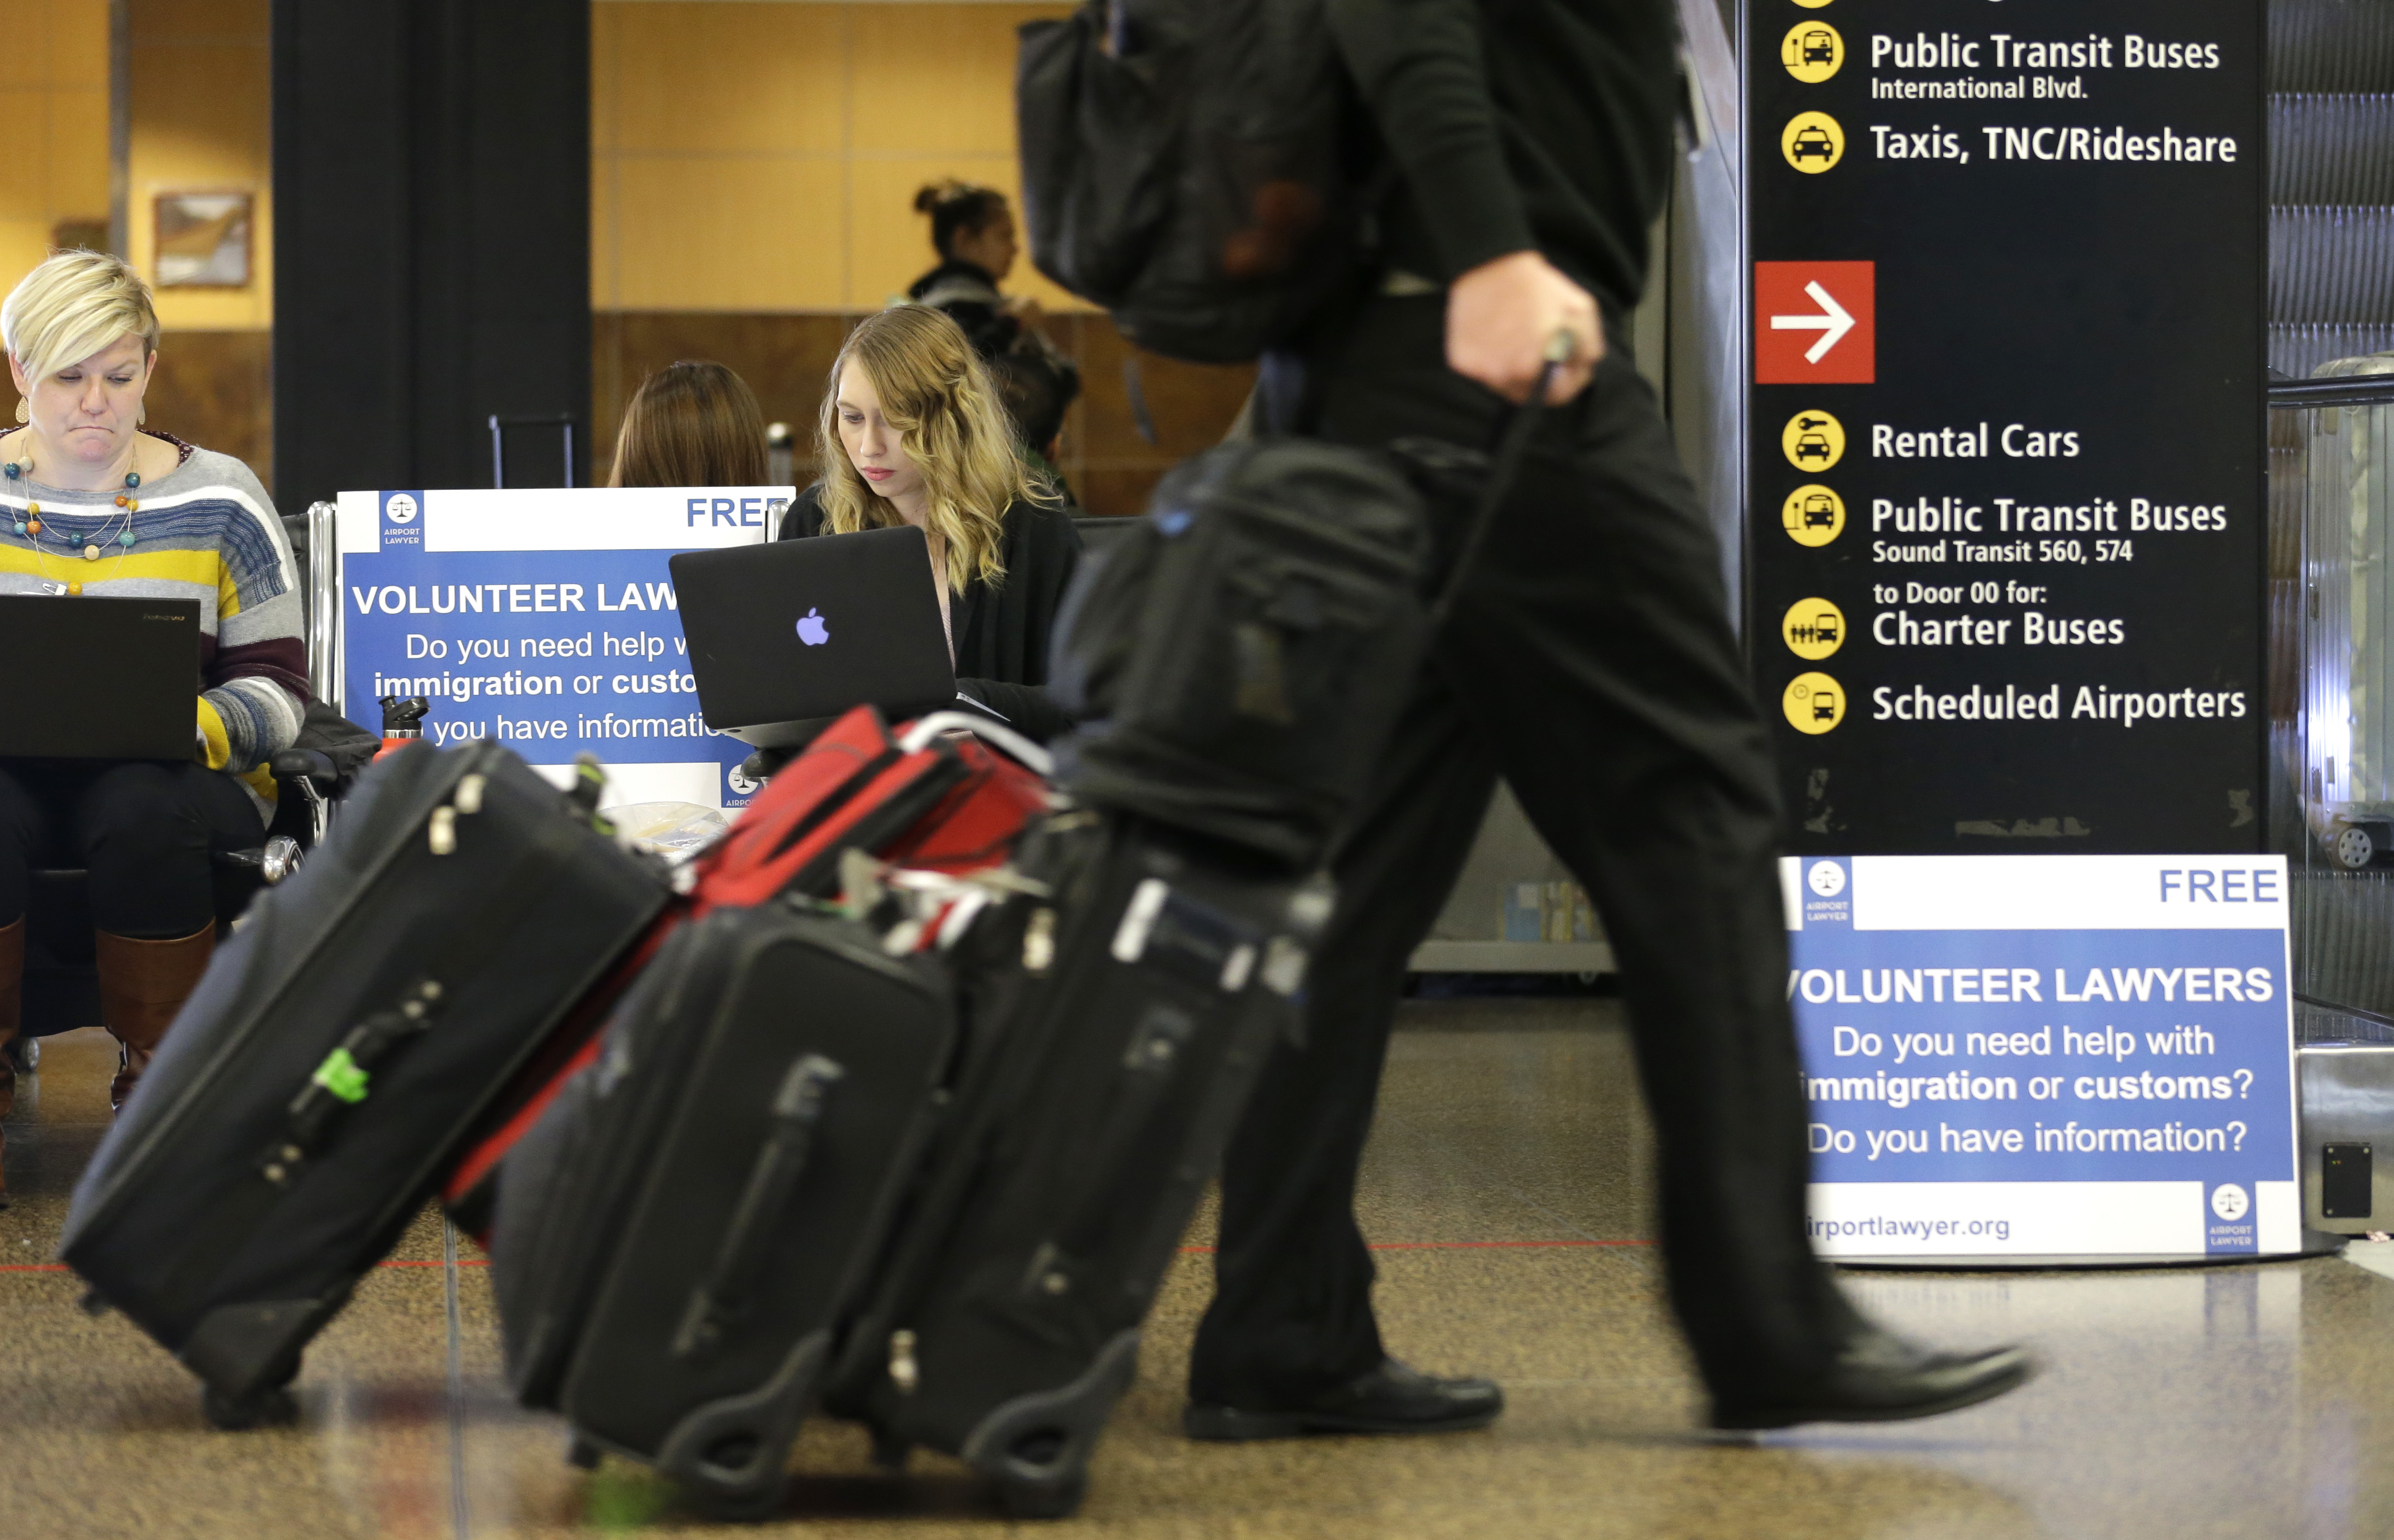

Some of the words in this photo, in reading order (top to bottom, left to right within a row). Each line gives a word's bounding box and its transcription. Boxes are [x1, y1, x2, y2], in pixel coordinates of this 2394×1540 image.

[1872, 33, 1979, 68] Public
[1990, 34, 2112, 68] Transit
[2125, 35, 2219, 68] Buses
[1872, 75, 2024, 99] International
[2033, 75, 2087, 99] Blvd.
[1870, 125, 1969, 164] Taxis,
[1982, 126, 2237, 162] TNC/Rideshare
[1873, 422, 1987, 457] Rental
[2001, 423, 2079, 457] Cars
[1873, 497, 1982, 532] Public
[1993, 497, 2118, 532] Transit
[2131, 498, 2226, 531] Buses
[1873, 539, 1946, 562] Sound
[1952, 540, 2032, 562] Transit
[2039, 540, 2087, 564] 560,
[2096, 540, 2133, 561] 574
[352, 584, 586, 614] VOLUNTEER
[1873, 584, 1899, 604] to
[1906, 582, 1964, 604] Door
[1970, 581, 1999, 604] 00
[2006, 580, 2046, 603] for:
[1873, 610, 2011, 645] Charter
[2024, 612, 2124, 644] Buses
[407, 634, 447, 659] Do
[457, 639, 509, 665] you
[521, 632, 592, 657] need
[603, 631, 665, 662] help
[375, 670, 563, 702] immigration
[573, 675, 603, 694] or
[612, 669, 697, 694] custo
[1873, 684, 2059, 720] Scheduled
[2071, 685, 2246, 728] Airporters
[433, 721, 485, 747] you
[497, 714, 567, 740] have
[2160, 870, 2278, 902] FREE
[2055, 967, 2273, 1002] LAWYERS
[1833, 1026, 1882, 1056] Do
[1892, 1032, 1954, 1064] you
[1966, 1025, 2051, 1056] need
[2063, 1025, 2136, 1063] help
[2145, 1025, 2214, 1055] with
[2028, 1077, 2064, 1100] or
[2074, 1068, 2253, 1100] customs?
[1807, 1123, 1857, 1153] Do
[1865, 1129, 1928, 1161] you
[1940, 1122, 2024, 1152] have
[2035, 1120, 2247, 1152] information?
[1807, 1216, 2010, 1240] irportlawyer.org
[2210, 1226, 2252, 1235] AIRPORT
[2211, 1236, 2252, 1246] LAWYER
